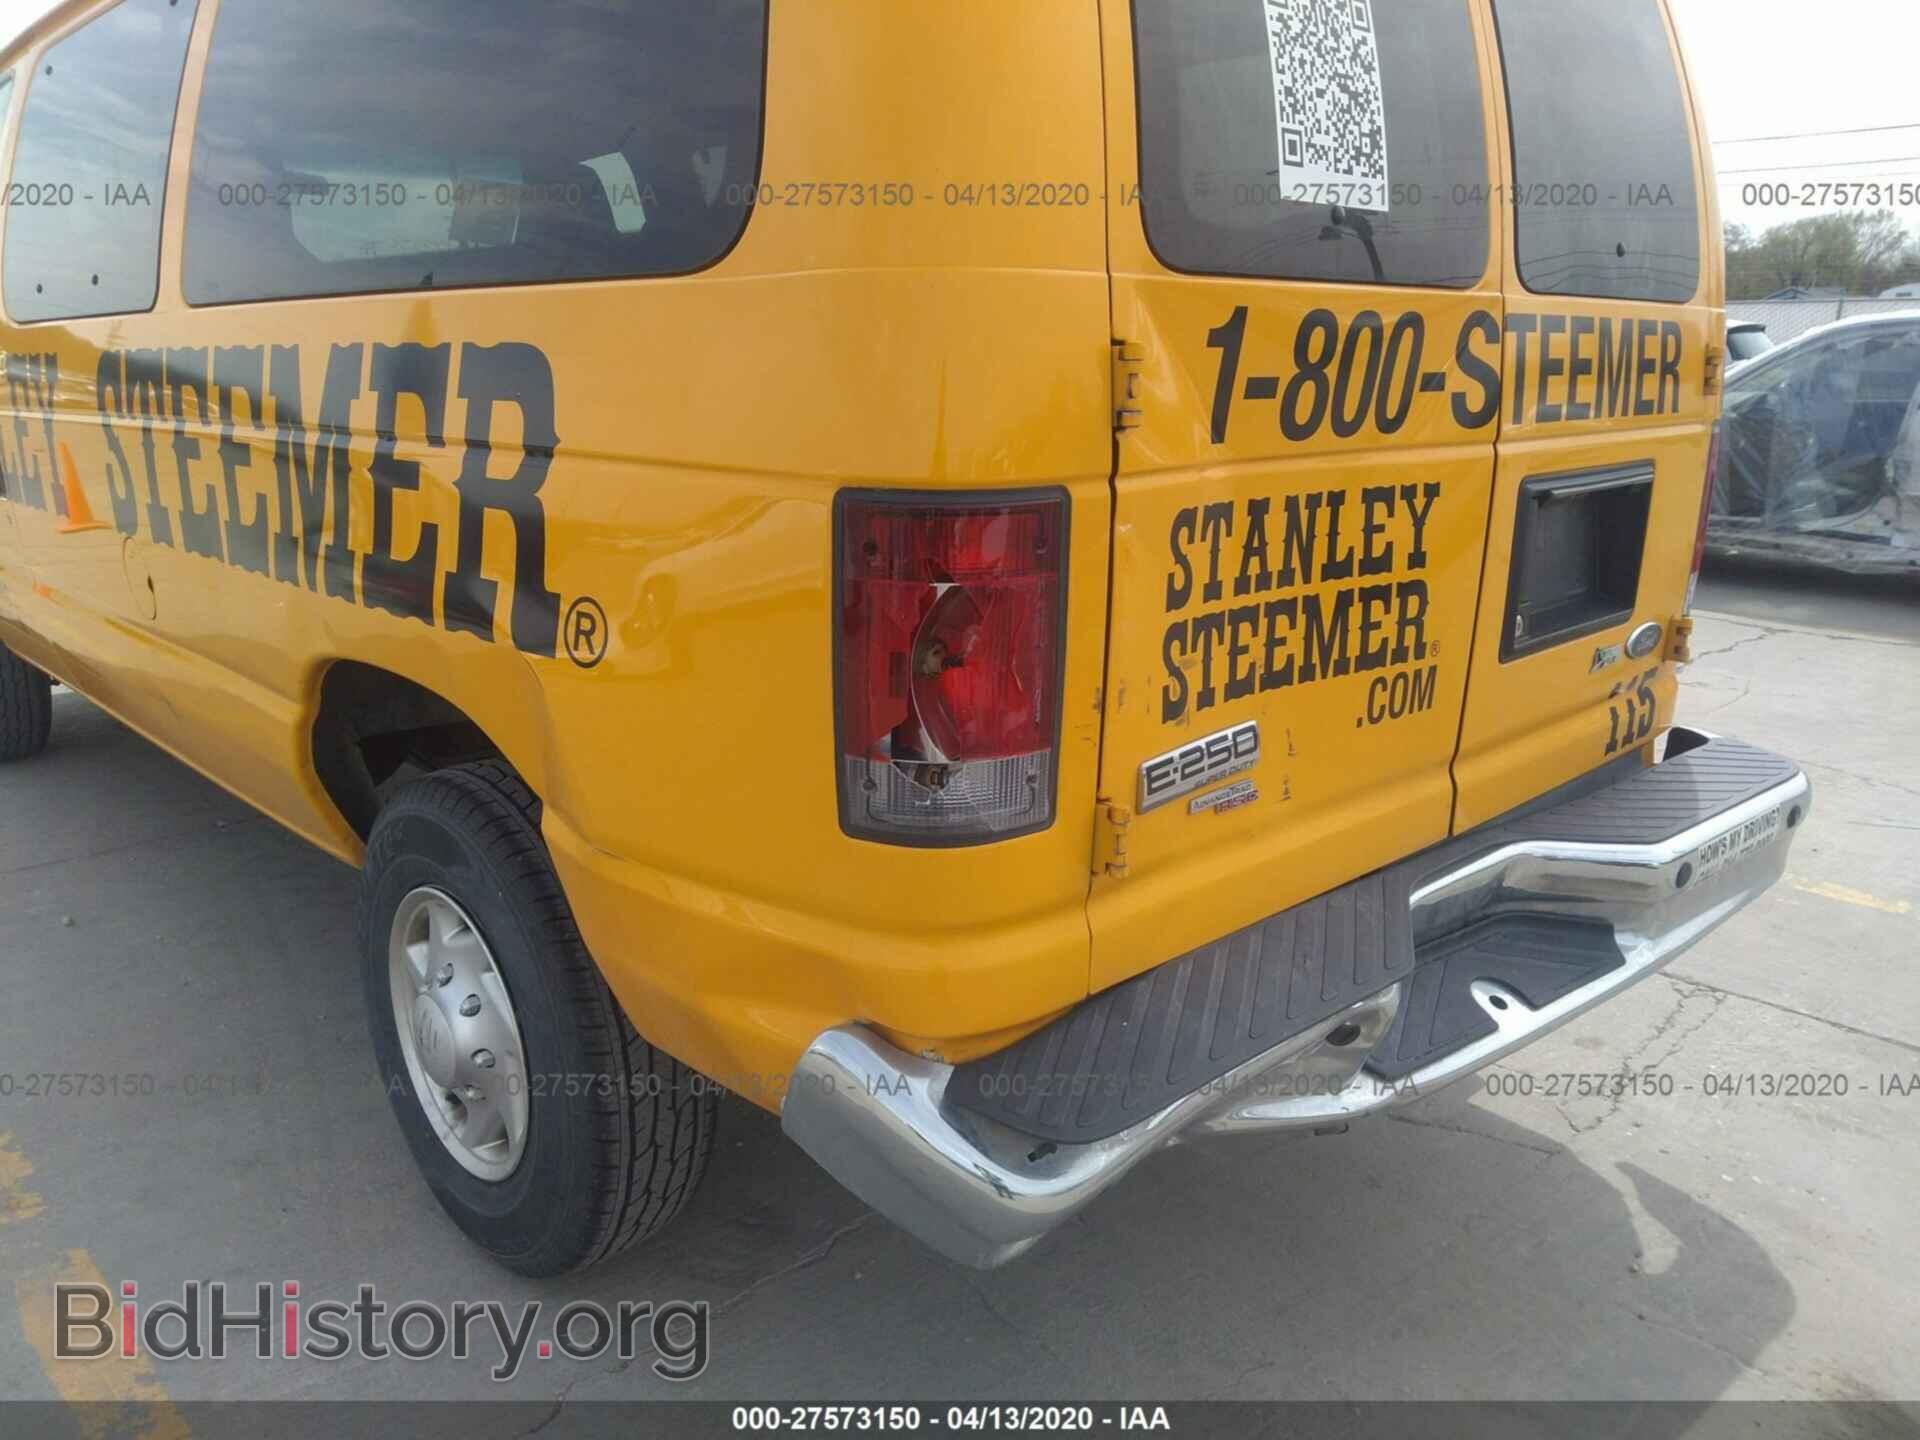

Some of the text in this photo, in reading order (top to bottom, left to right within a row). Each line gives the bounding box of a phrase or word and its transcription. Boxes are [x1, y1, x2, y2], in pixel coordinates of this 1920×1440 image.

[1205, 304, 1682, 444] 1-800-STEEMER
[96, 341, 562, 659] STEEMER
[1165, 481, 1441, 613] STANLEY
[1161, 579, 1428, 724] STEEMER
[1356, 665, 1437, 728] .COM
[1604, 665, 1659, 757] 115
[1145, 724, 1258, 796] E-250
